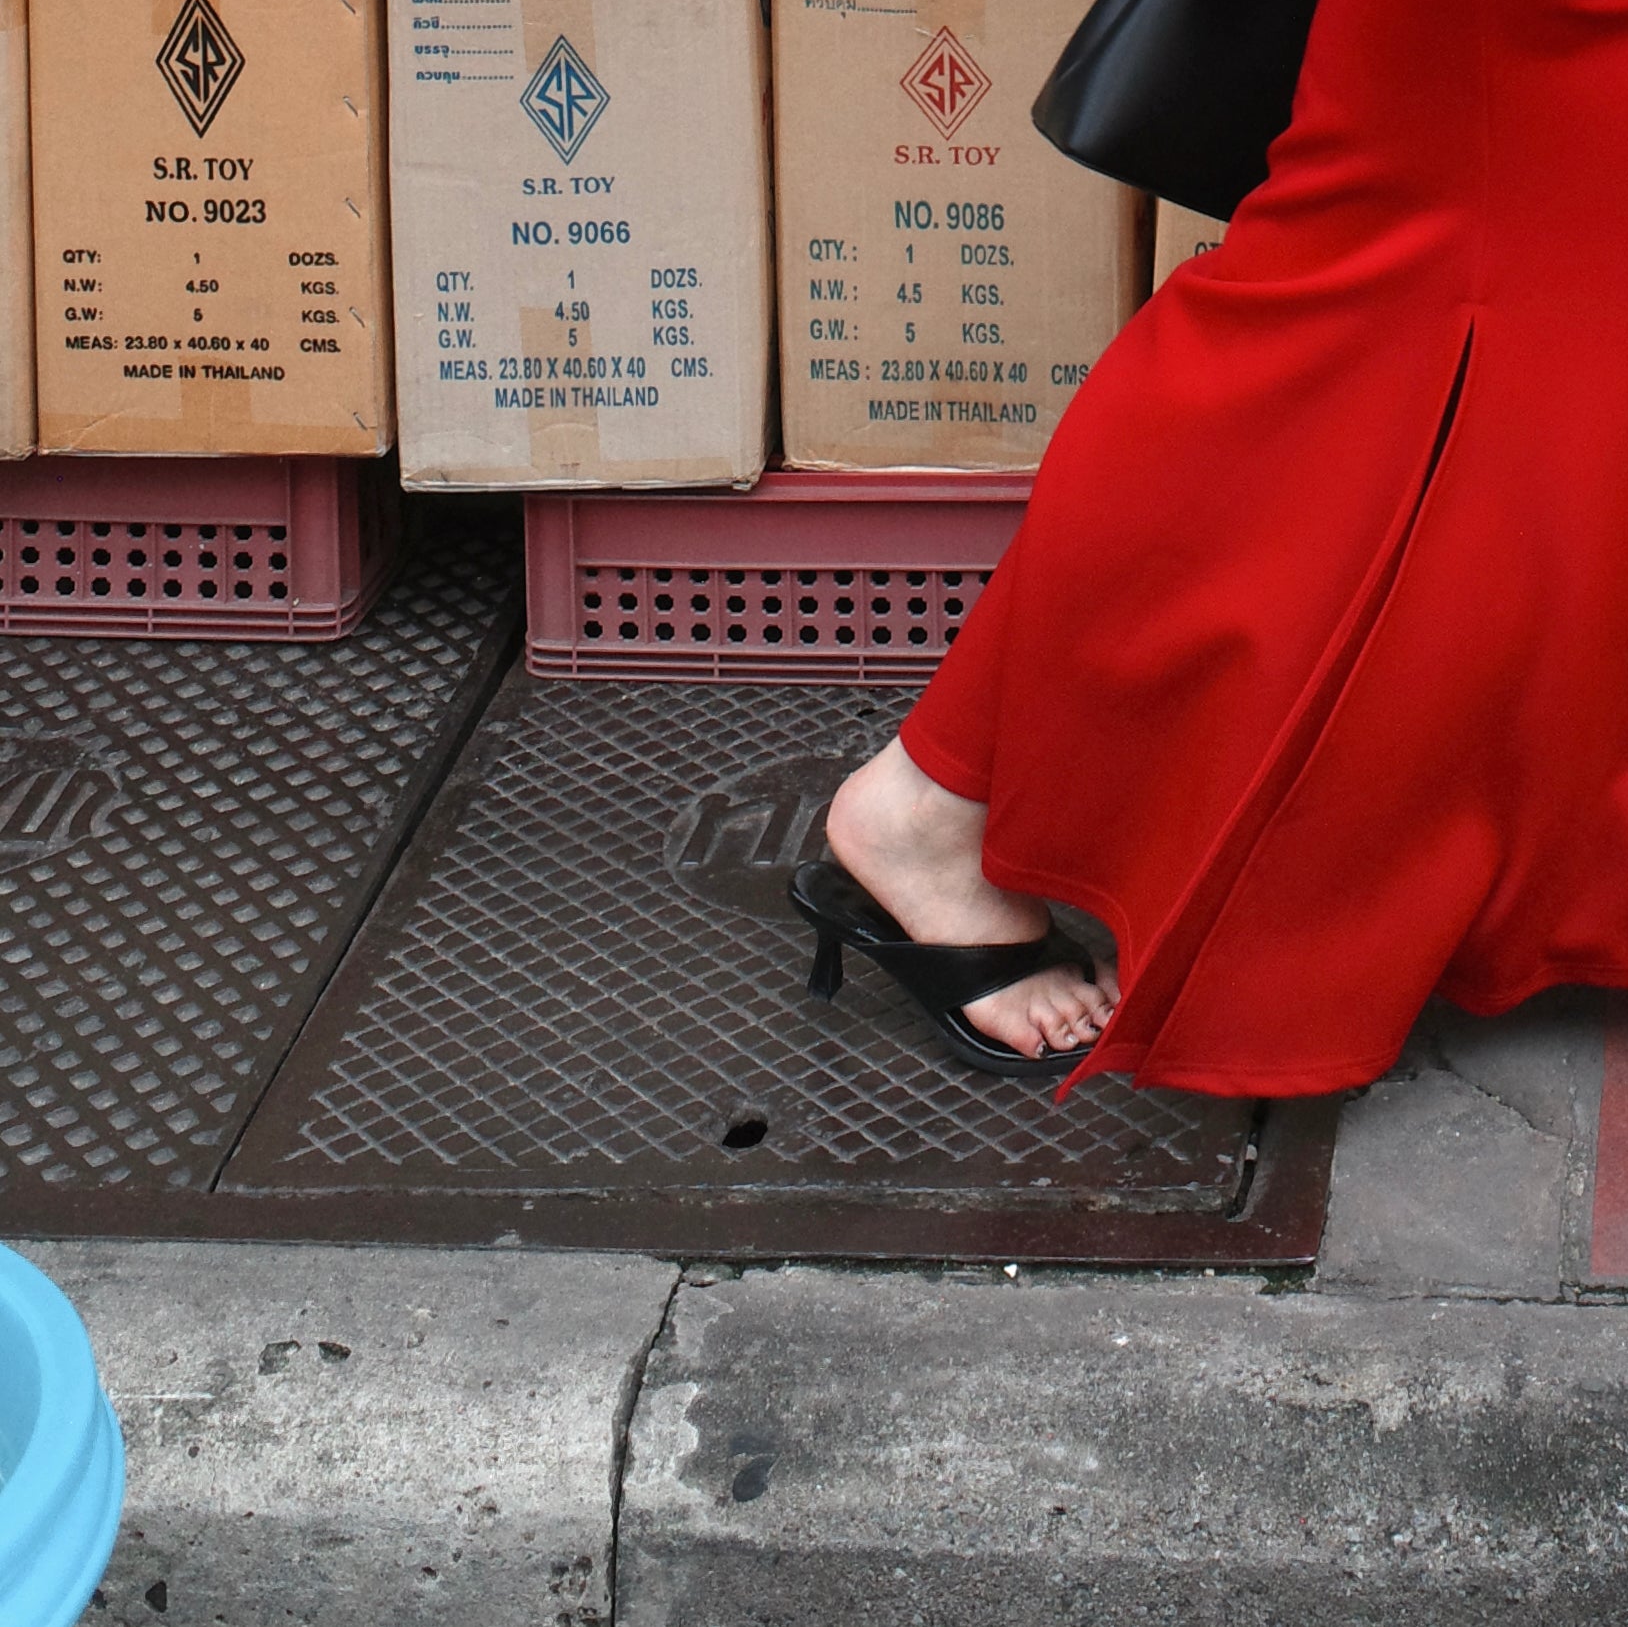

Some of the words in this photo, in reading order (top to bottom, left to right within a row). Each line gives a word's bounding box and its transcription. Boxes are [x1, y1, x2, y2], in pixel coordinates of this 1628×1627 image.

[895, 145, 940, 164] S.R.
[949, 147, 1000, 165] TOY
[154, 157, 197, 180] S.R.
[204, 158, 253, 180] TOY
[523, 178, 562, 194] S.R.
[570, 177, 614, 194] TOY
[146, 201, 196, 222] NO.
[204, 200, 266, 223] 9023
[895, 201, 938, 229] NO.
[947, 203, 1004, 230] 9086
[513, 222, 559, 245] NO.
[569, 221, 630, 244] 9066
[63, 250, 100, 263] QTY:
[194, 253, 200, 264] 1
[289, 252, 338, 266] DOZS.
[906, 244, 913, 263] 1
[961, 244, 1014, 265] DOZS.
[64, 279, 101, 291] N.W:
[186, 280, 219, 293] 4.50
[301, 282, 338, 295] KGS.
[437, 272, 473, 292] QTY.
[568, 270, 574, 289] 1
[652, 268, 702, 288] DOZS.
[897, 283, 922, 303] 4.5
[962, 284, 1004, 305] KGS.
[65, 307, 102, 321] G.W:
[194, 308, 203, 321] 5
[302, 310, 339, 323] KGS.
[438, 302, 474, 321] N.W.
[555, 301, 589, 321] 4.50
[652, 299, 693, 319] KGS.
[66, 336, 117, 350] MEAS:
[125, 336, 167, 349] 23.80
[188, 337, 230, 350] 40.60
[251, 338, 269, 351] 40
[300, 338, 341, 352] CMS.
[439, 329, 475, 348] G.W.
[569, 328, 577, 347] 5
[654, 326, 694, 345] KGS.
[906, 322, 915, 343] 5
[963, 323, 1004, 344] KGS.
[124, 365, 172, 378] MADE
[179, 365, 196, 378] IN
[201, 365, 285, 380] THAILAND
[440, 360, 492, 380] MEAS.
[499, 357, 542, 379] 23.80
[563, 357, 606, 378] 40.60
[627, 357, 645, 378] 40
[672, 357, 712, 377] CMS.
[882, 360, 924, 381] 23.80
[945, 360, 988, 381] 40.60
[1008, 363, 1027, 382] 40
[496, 388, 545, 408] MADE
[550, 388, 566, 407] IN
[571, 386, 658, 407] THAILAND
[869, 400, 919, 420] MADE
[925, 401, 942, 420] IN
[947, 401, 1036, 423] THAILAND
